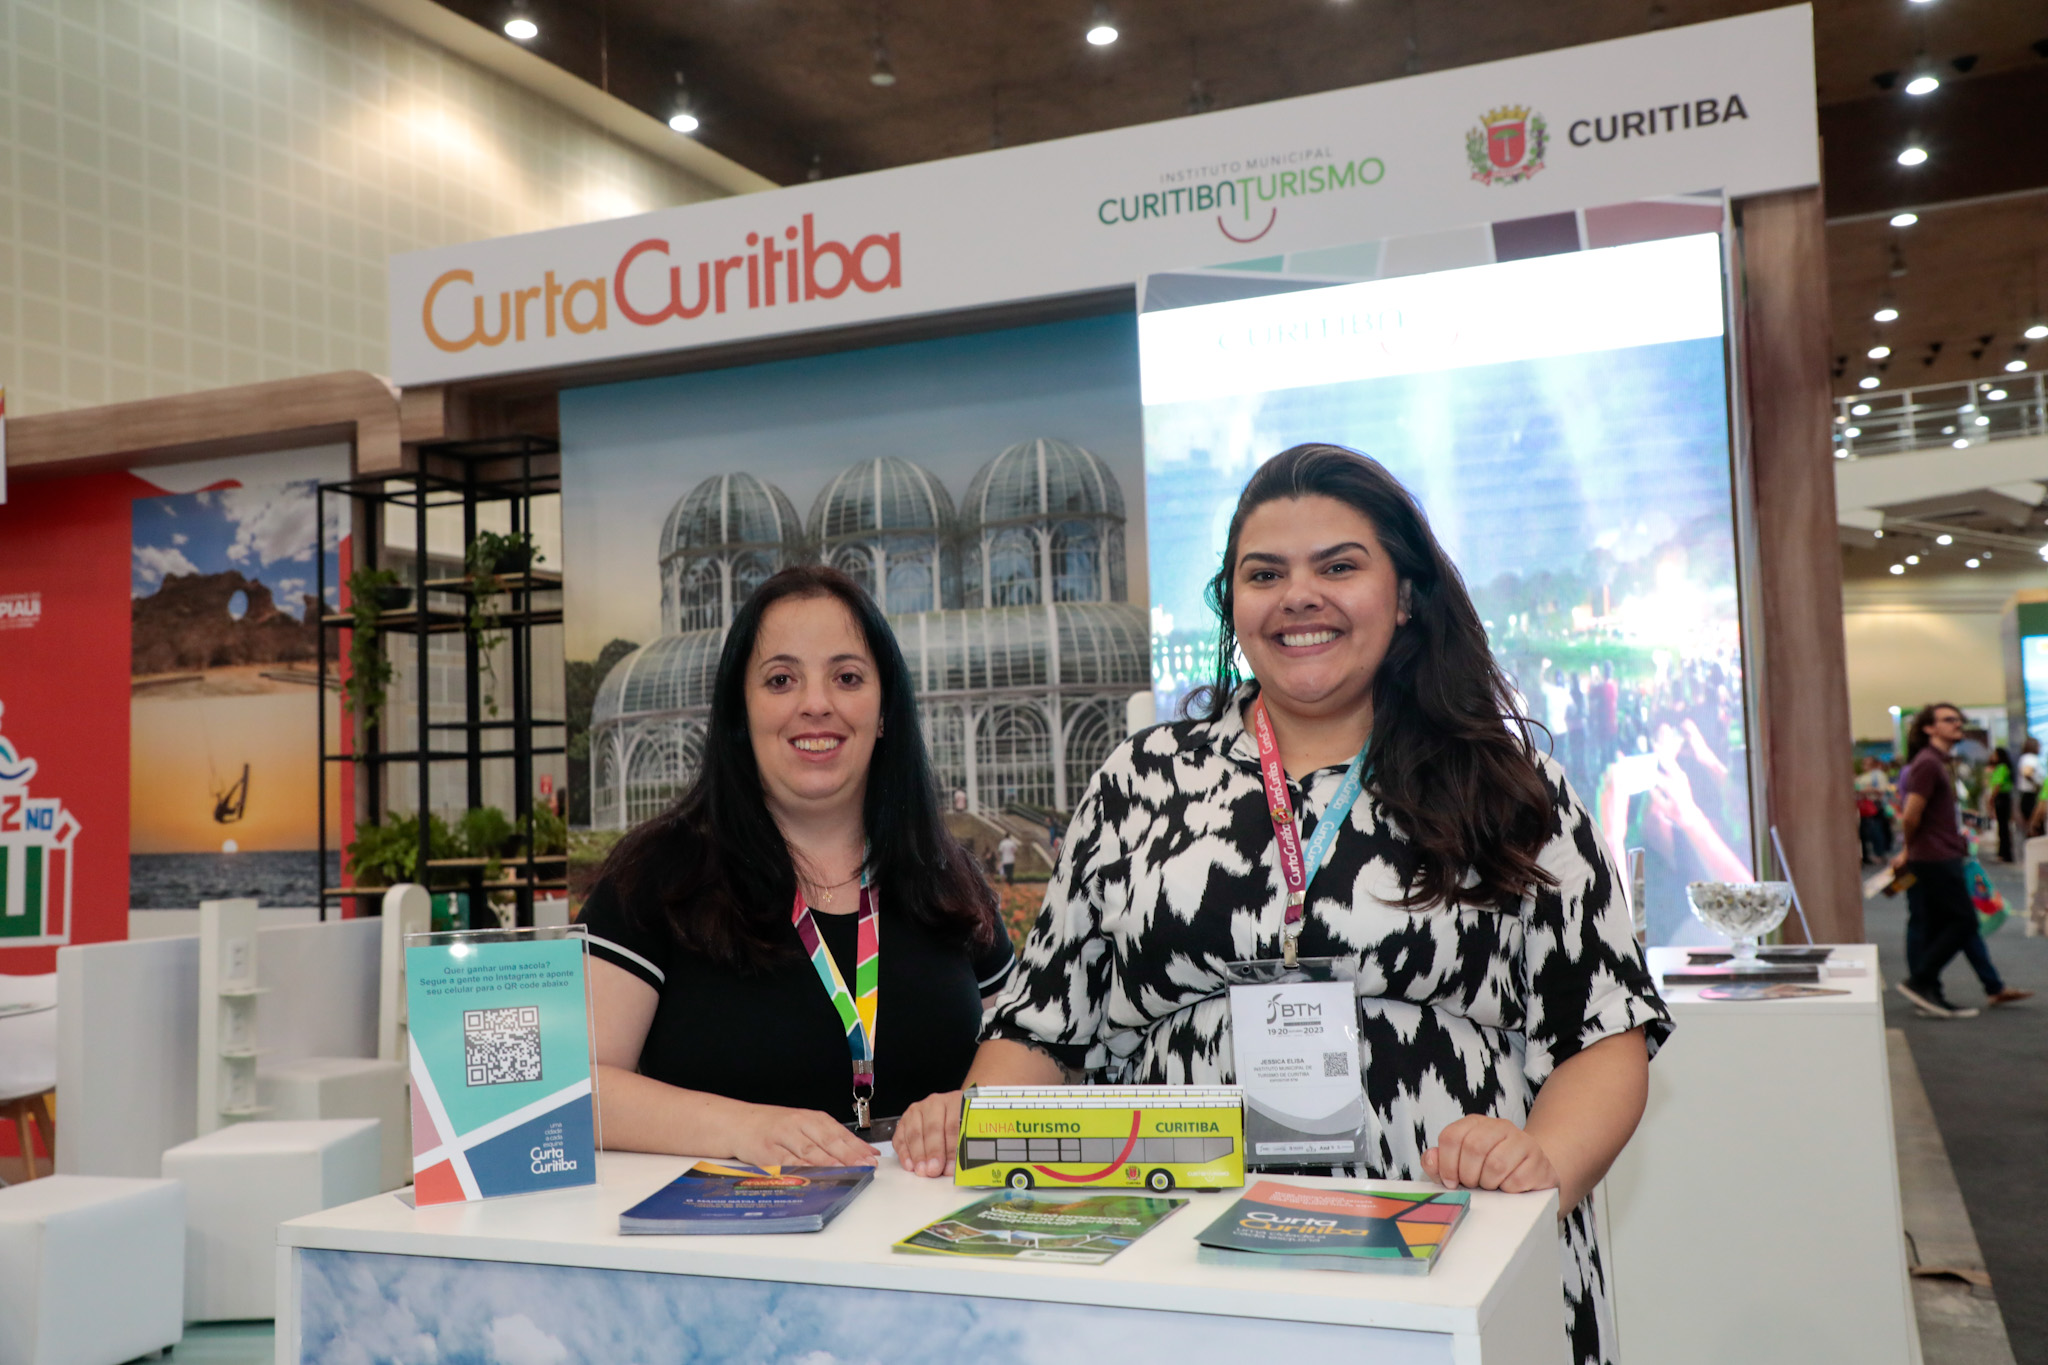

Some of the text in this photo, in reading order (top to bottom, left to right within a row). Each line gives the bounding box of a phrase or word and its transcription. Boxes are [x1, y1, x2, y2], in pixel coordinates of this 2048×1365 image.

[1568, 93, 1749, 147] CURITIBA
[1159, 147, 1333, 184] INSTITUTO MUNICIPAL
[444, 961, 551, 975] Quer ganhar uma sacola?
[419, 977, 447, 987] Segue
[457, 976, 480, 985] gente
[496, 971, 537, 982] Instagram
[546, 969, 574, 980] aponte
[426, 988, 442, 996] seu
[444, 985, 473, 995] celular
[475, 984, 495, 995] para
[504, 982, 518, 991] QR
[520, 981, 540, 990] code
[541, 979, 569, 989] abaixo
[1281, 1003, 1322, 1017] BTM
[1303, 1026, 1324, 1034] 2023
[1155, 1122, 1220, 1134] CURITIBA
[530, 1146, 564, 1161] Curta
[531, 1157, 577, 1175] Curitiba
[1247, 1211, 1338, 1227] Curta
[1239, 1219, 1370, 1237] Curitiba
